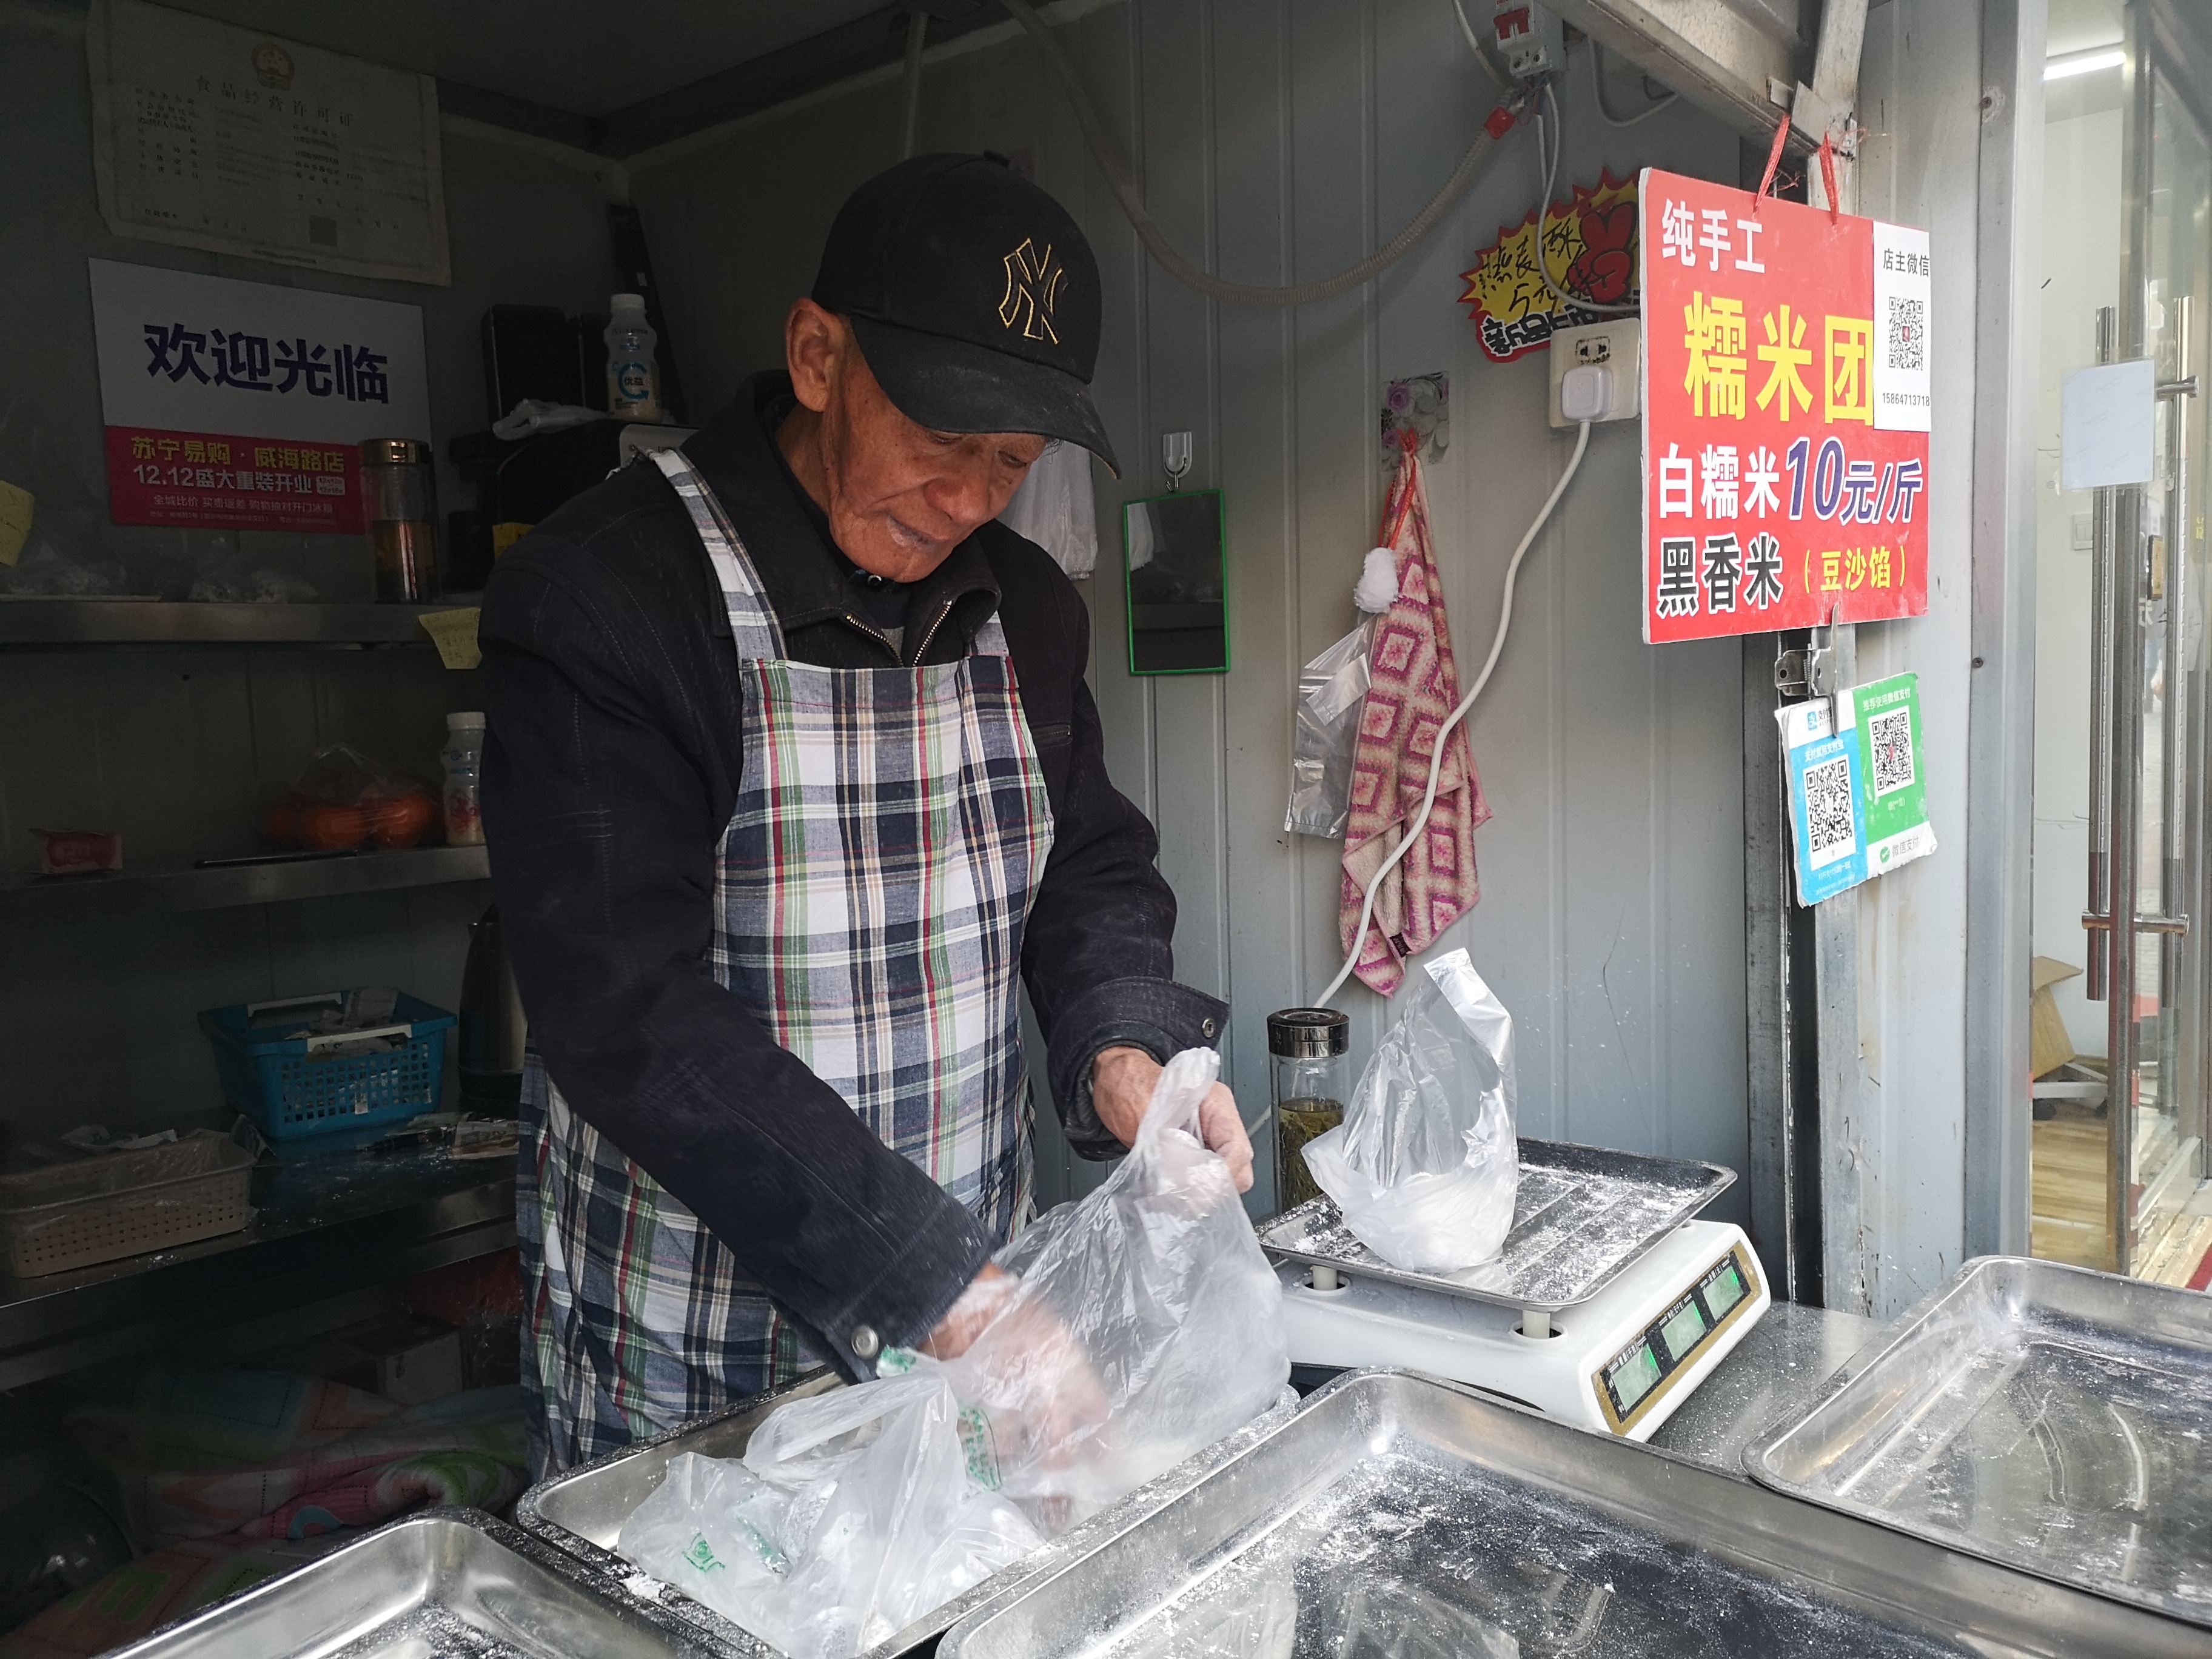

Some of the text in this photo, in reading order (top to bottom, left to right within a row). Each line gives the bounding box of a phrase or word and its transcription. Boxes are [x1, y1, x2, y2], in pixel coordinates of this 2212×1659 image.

[1661, 198, 1765, 273] 纯手工
[1883, 247, 1930, 278] 店主微信
[144, 323, 389, 404] 欢迎光临
[1683, 290, 1874, 426] 糯米团
[1882, 392, 1931, 407] 15864713718
[133, 464, 313, 495] 12.12盛大重装开业
[1658, 436, 1923, 526] 白糯米 10元/斤
[1657, 532, 1784, 619] 黑香米
[1892, 836, 1919, 857] 微信支付
